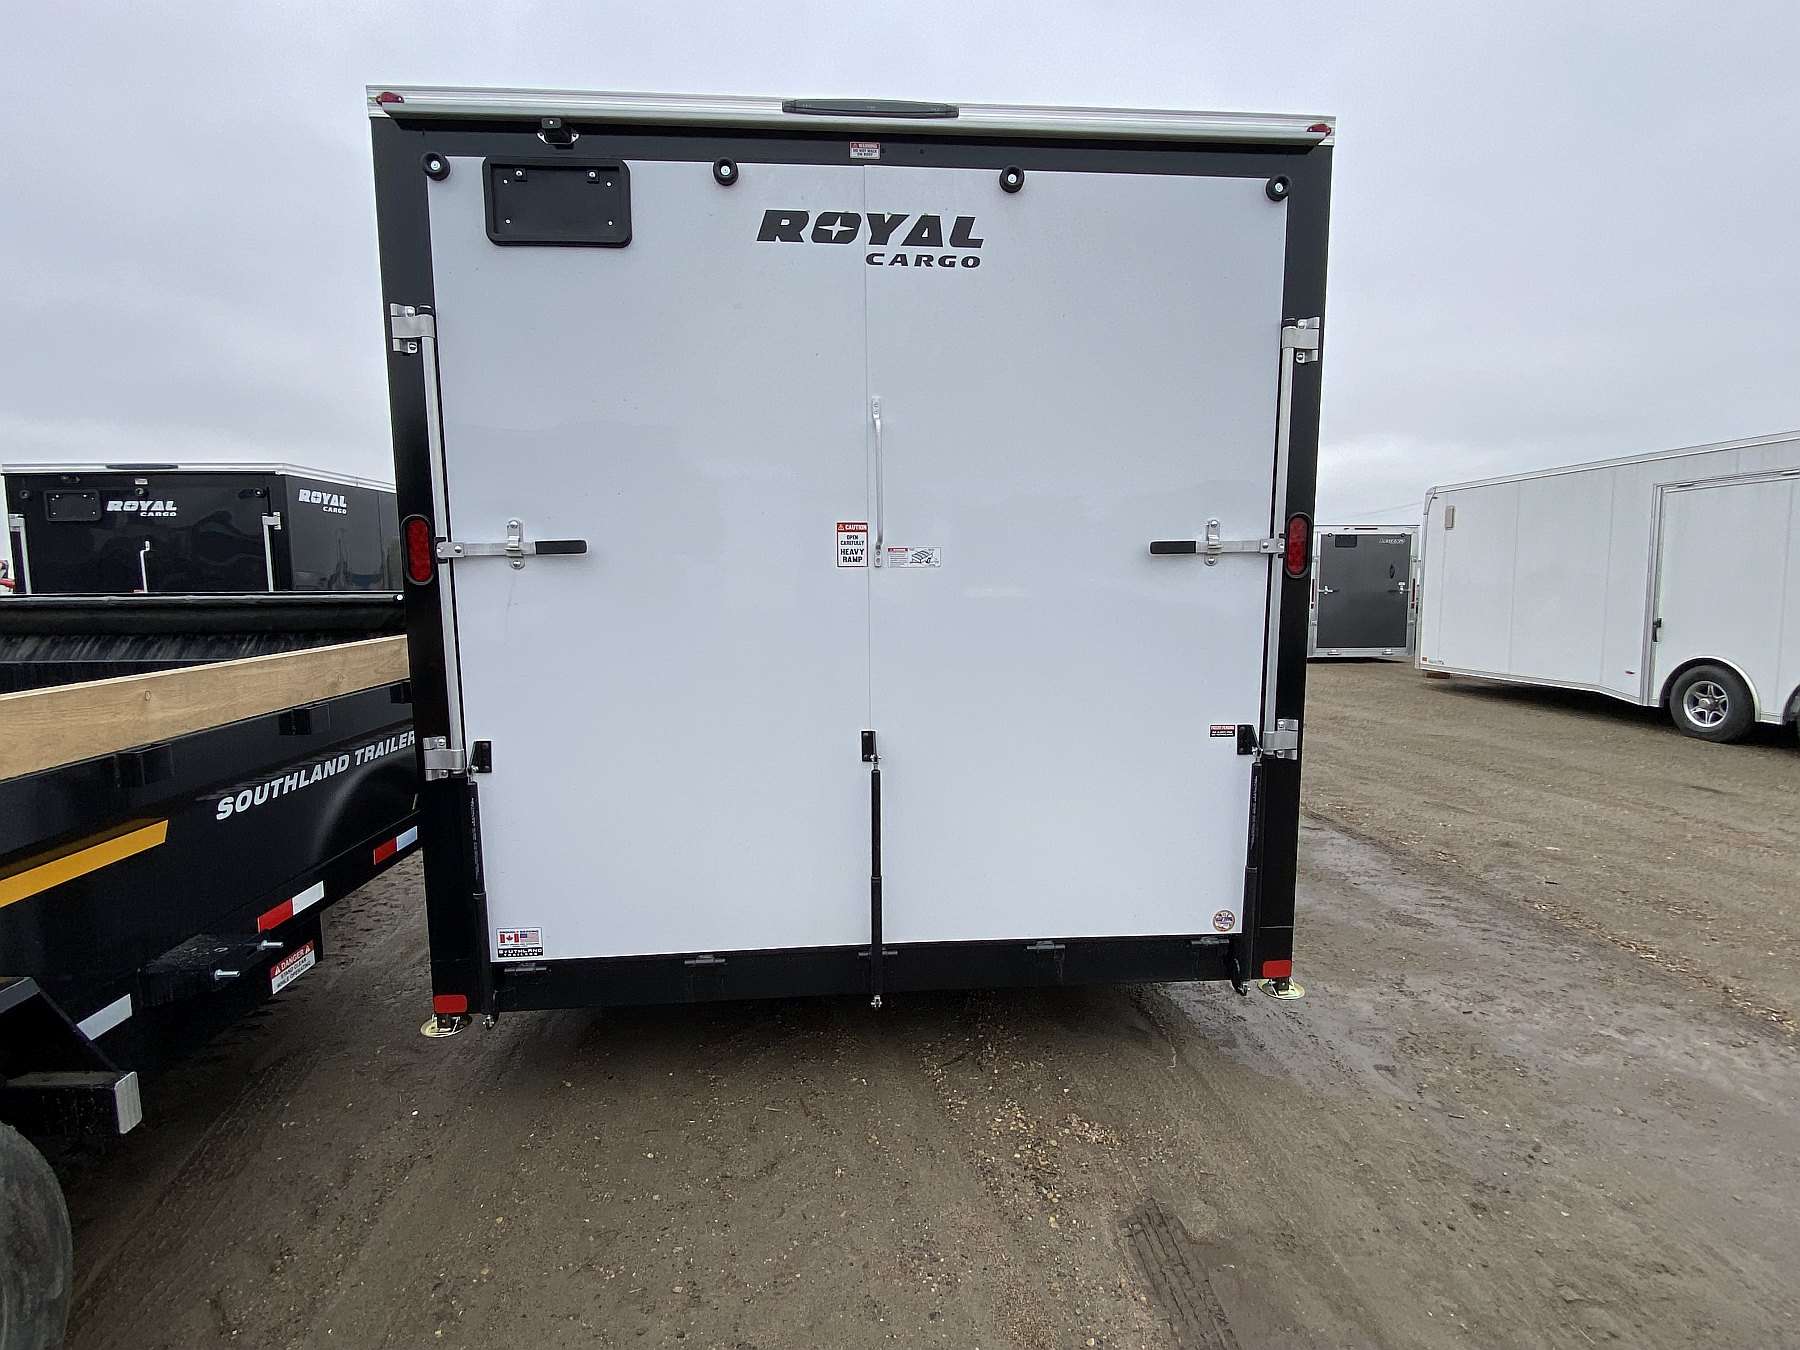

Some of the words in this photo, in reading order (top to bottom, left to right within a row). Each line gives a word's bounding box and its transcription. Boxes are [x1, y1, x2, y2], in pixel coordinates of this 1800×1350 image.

[756, 209, 985, 249] ROYAL
[866, 253, 981, 269] CARGO
[106, 500, 177, 511] ROYAL
[298, 489, 347, 508] ROYAL
[322, 506, 347, 514] CARGO
[840, 548, 865, 556] HEAVY
[216, 754, 350, 820] SOUTHLAND
[354, 730, 415, 766] TRAILER
[280, 949, 304, 970] DANGER
